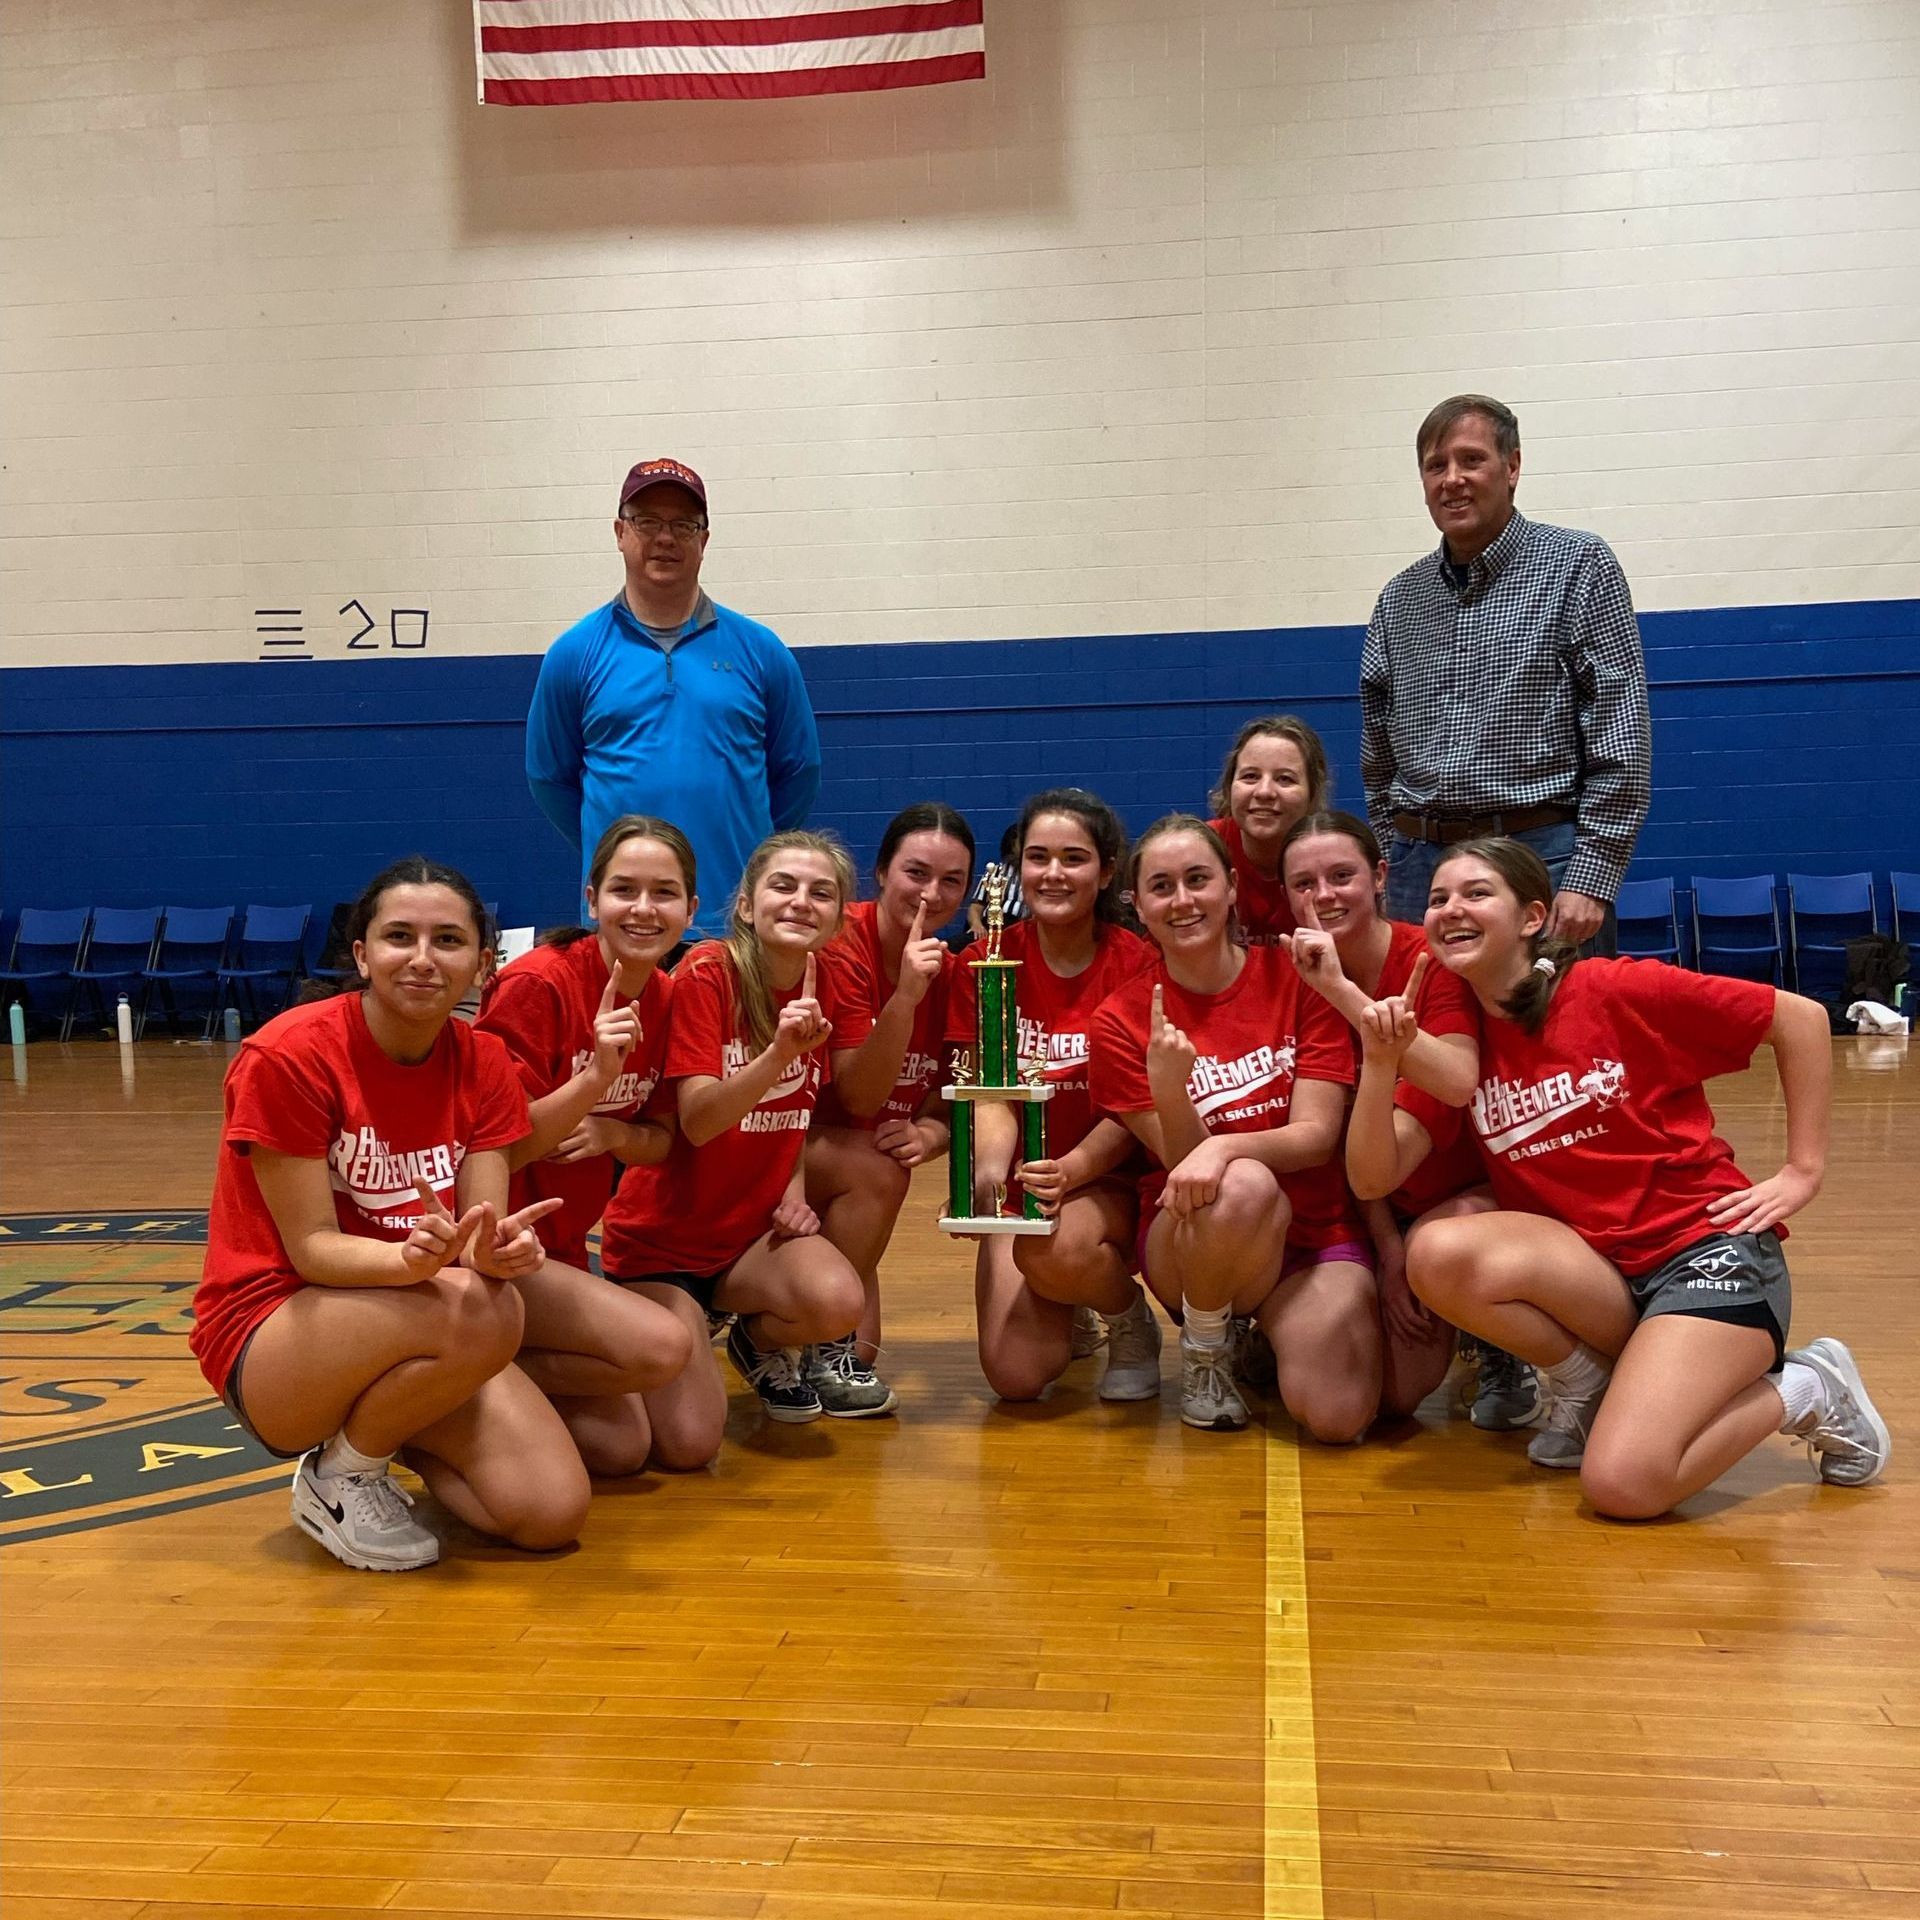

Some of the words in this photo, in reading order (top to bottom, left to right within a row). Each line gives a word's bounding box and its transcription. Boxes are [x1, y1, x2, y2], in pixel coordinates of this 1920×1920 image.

[950, 1048, 971, 1069] 20
[1185, 1045, 1274, 1100] EDEEMER
[1193, 1055, 1217, 1069] OLY
[1469, 1071, 1577, 1135] REDEEMER
[329, 1128, 455, 1190] REDEEMER
[1507, 1123, 1609, 1162] BASKEBALL
[1686, 1279, 1741, 1293] HOCKEY
